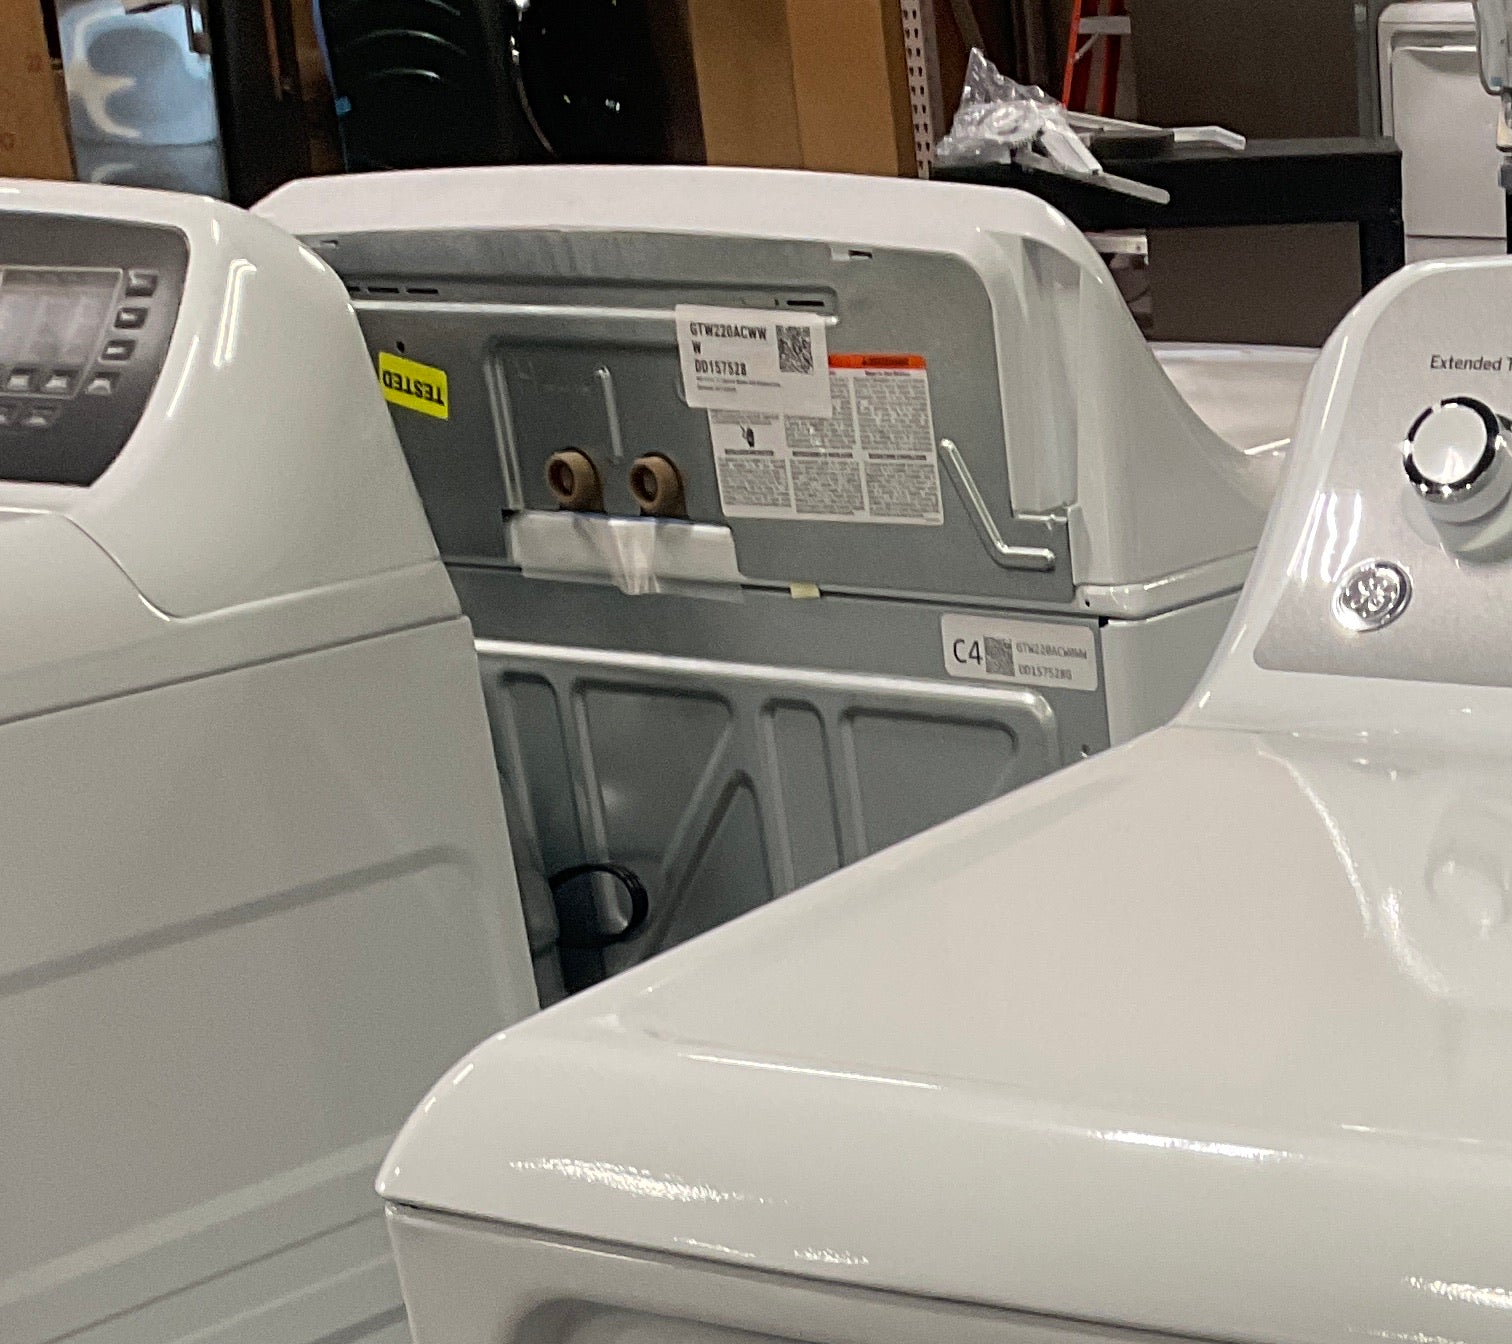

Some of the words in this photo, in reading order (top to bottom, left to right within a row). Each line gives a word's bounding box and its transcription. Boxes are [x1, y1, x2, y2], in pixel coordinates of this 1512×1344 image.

[690, 321, 767, 341] GTW220ACWW
[695, 359, 747, 377] DD157528
[1430, 354, 1502, 371] Extended
[382, 370, 445, 407] TESTED
[952, 637, 984, 666] C4
